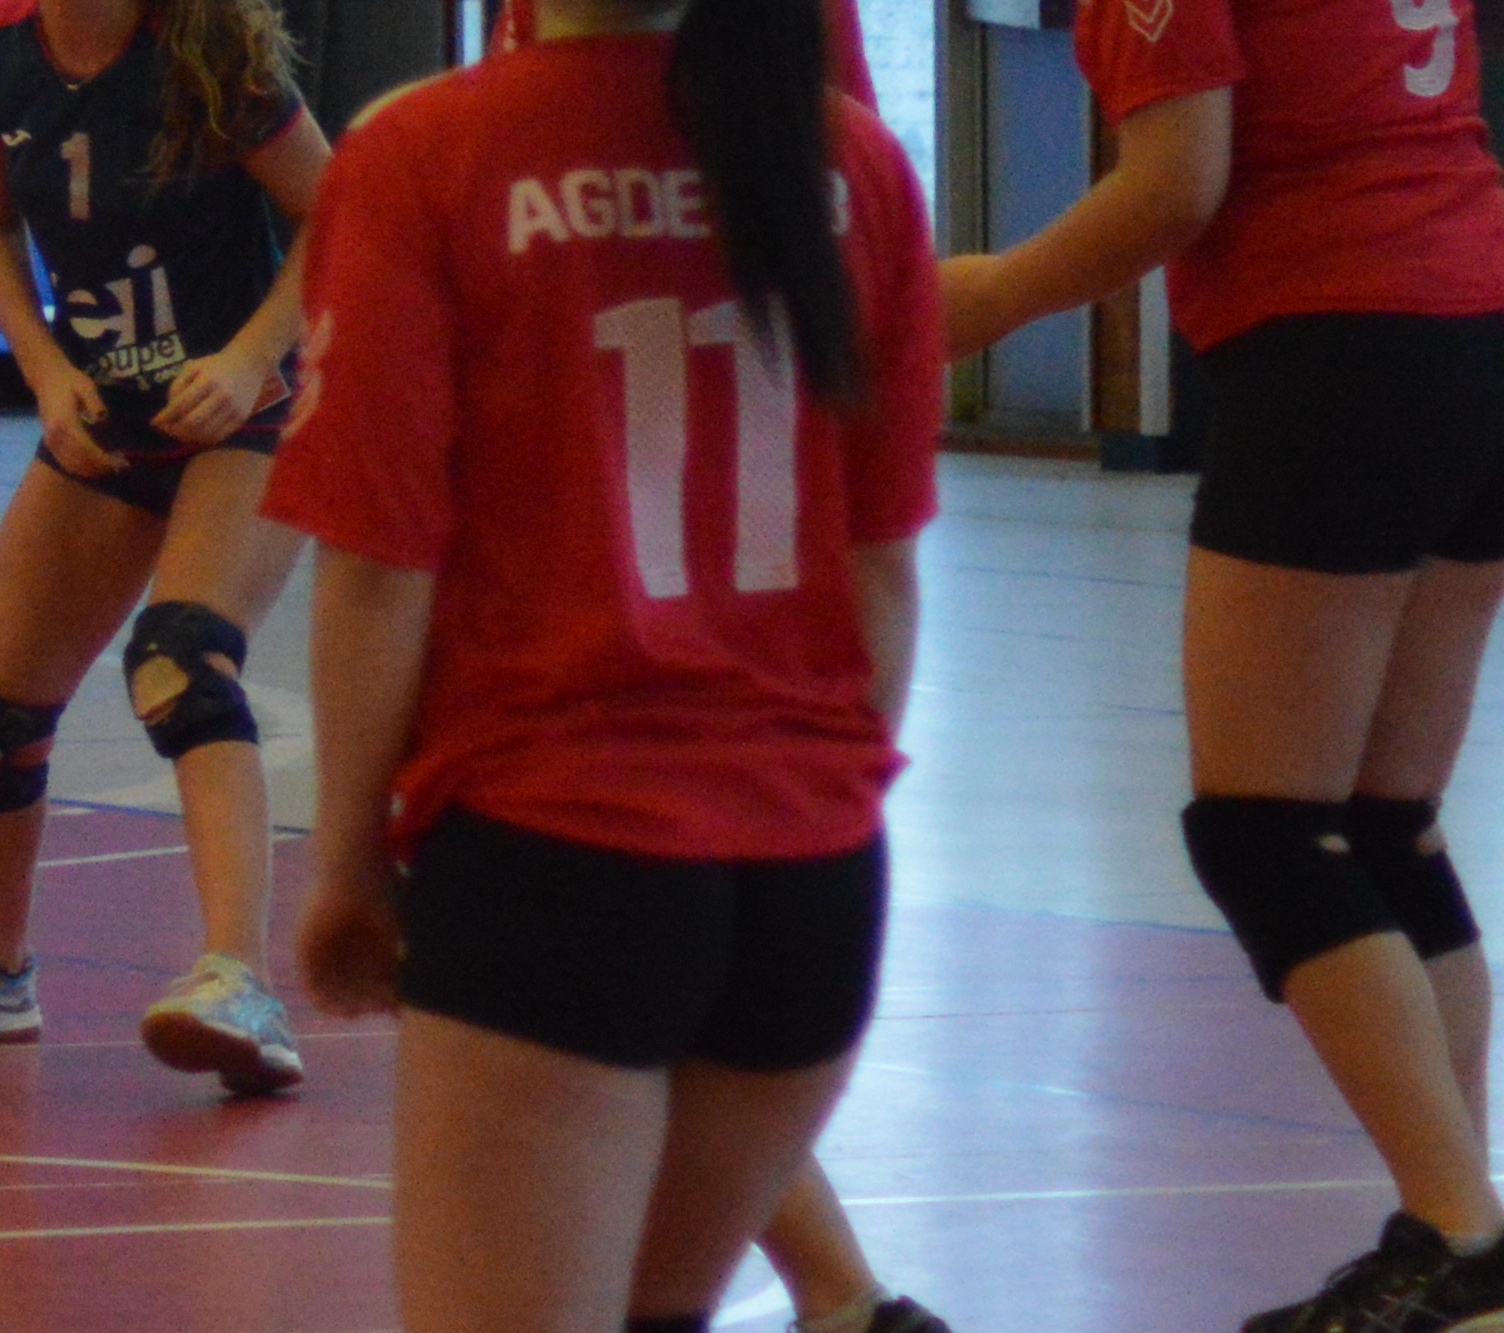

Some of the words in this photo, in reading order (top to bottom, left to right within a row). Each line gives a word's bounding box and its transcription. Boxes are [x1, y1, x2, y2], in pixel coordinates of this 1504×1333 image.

[60, 132, 91, 222] 1
[507, 169, 714, 256] AGDE
[591, 294, 799, 600] 11
